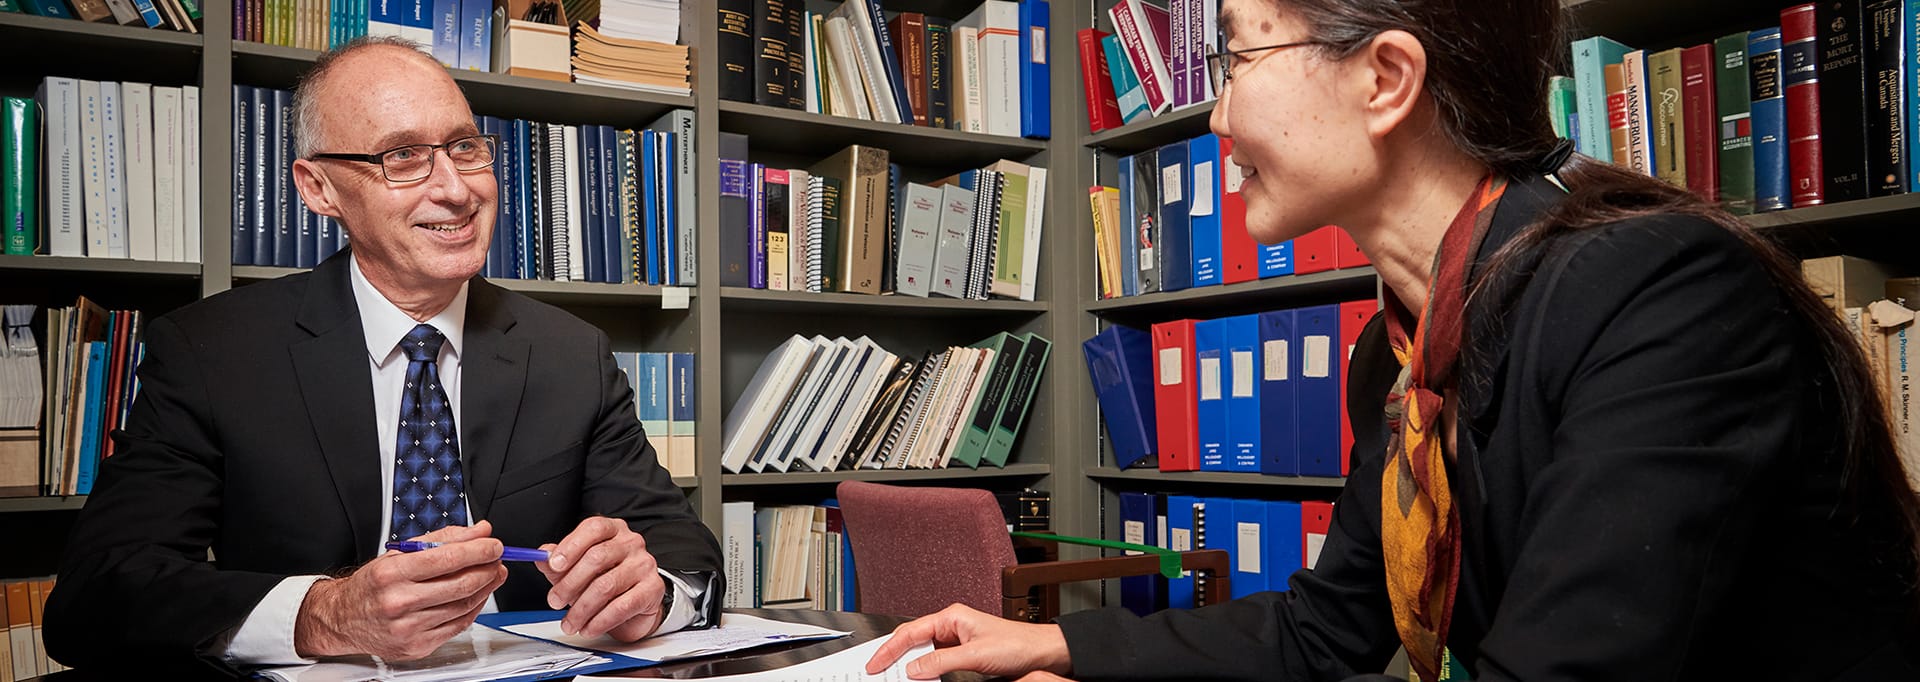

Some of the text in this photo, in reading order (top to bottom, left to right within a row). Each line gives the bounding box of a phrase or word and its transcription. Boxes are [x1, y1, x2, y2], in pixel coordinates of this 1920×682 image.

[444, 13, 452, 43] REPORT
[472, 18, 481, 48] REPORT
[874, 4, 890, 48] Auditing
[1830, 33, 1849, 45] THE
[931, 32, 939, 90] MANAGEMENT
[1823, 54, 1858, 72] REPORT
[1826, 44, 1854, 59] MORT
[1889, 69, 1898, 116] Acquisitions
[1629, 85, 1640, 146] MANAGERIAL
[1659, 91, 1667, 146] ACCOUNTING
[683, 117, 691, 174] MASTERTHINKER
[1890, 133, 1900, 164] Mergers
[1899, 336, 1908, 372] Principles
